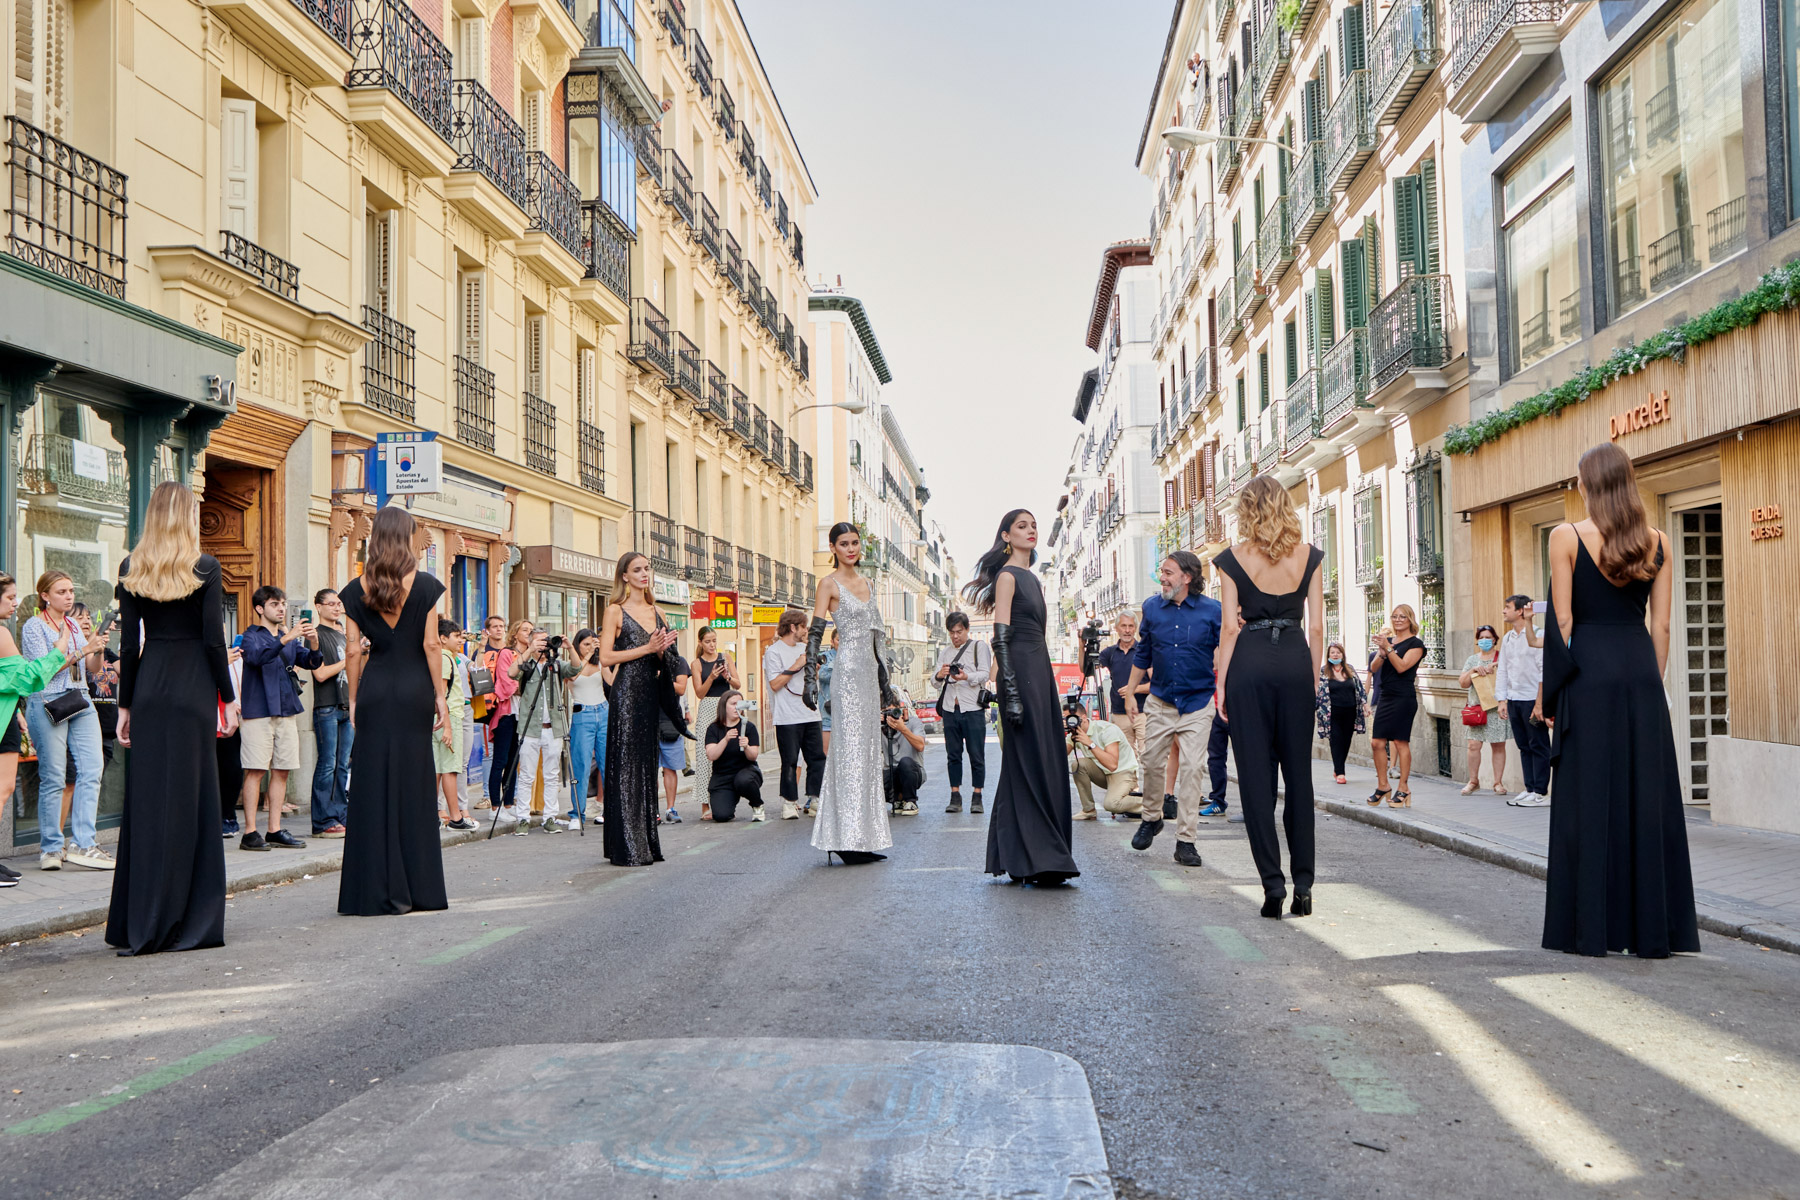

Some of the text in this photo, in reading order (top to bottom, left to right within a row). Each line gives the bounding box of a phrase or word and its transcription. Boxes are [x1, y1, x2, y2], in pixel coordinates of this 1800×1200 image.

[206, 374, 236, 406] 30
[1610, 390, 1671, 443] poncelet
[1749, 503, 1781, 523] TIENDA
[1750, 523, 1783, 541] QUESOS
[559, 552, 603, 577] FERRETERIA
